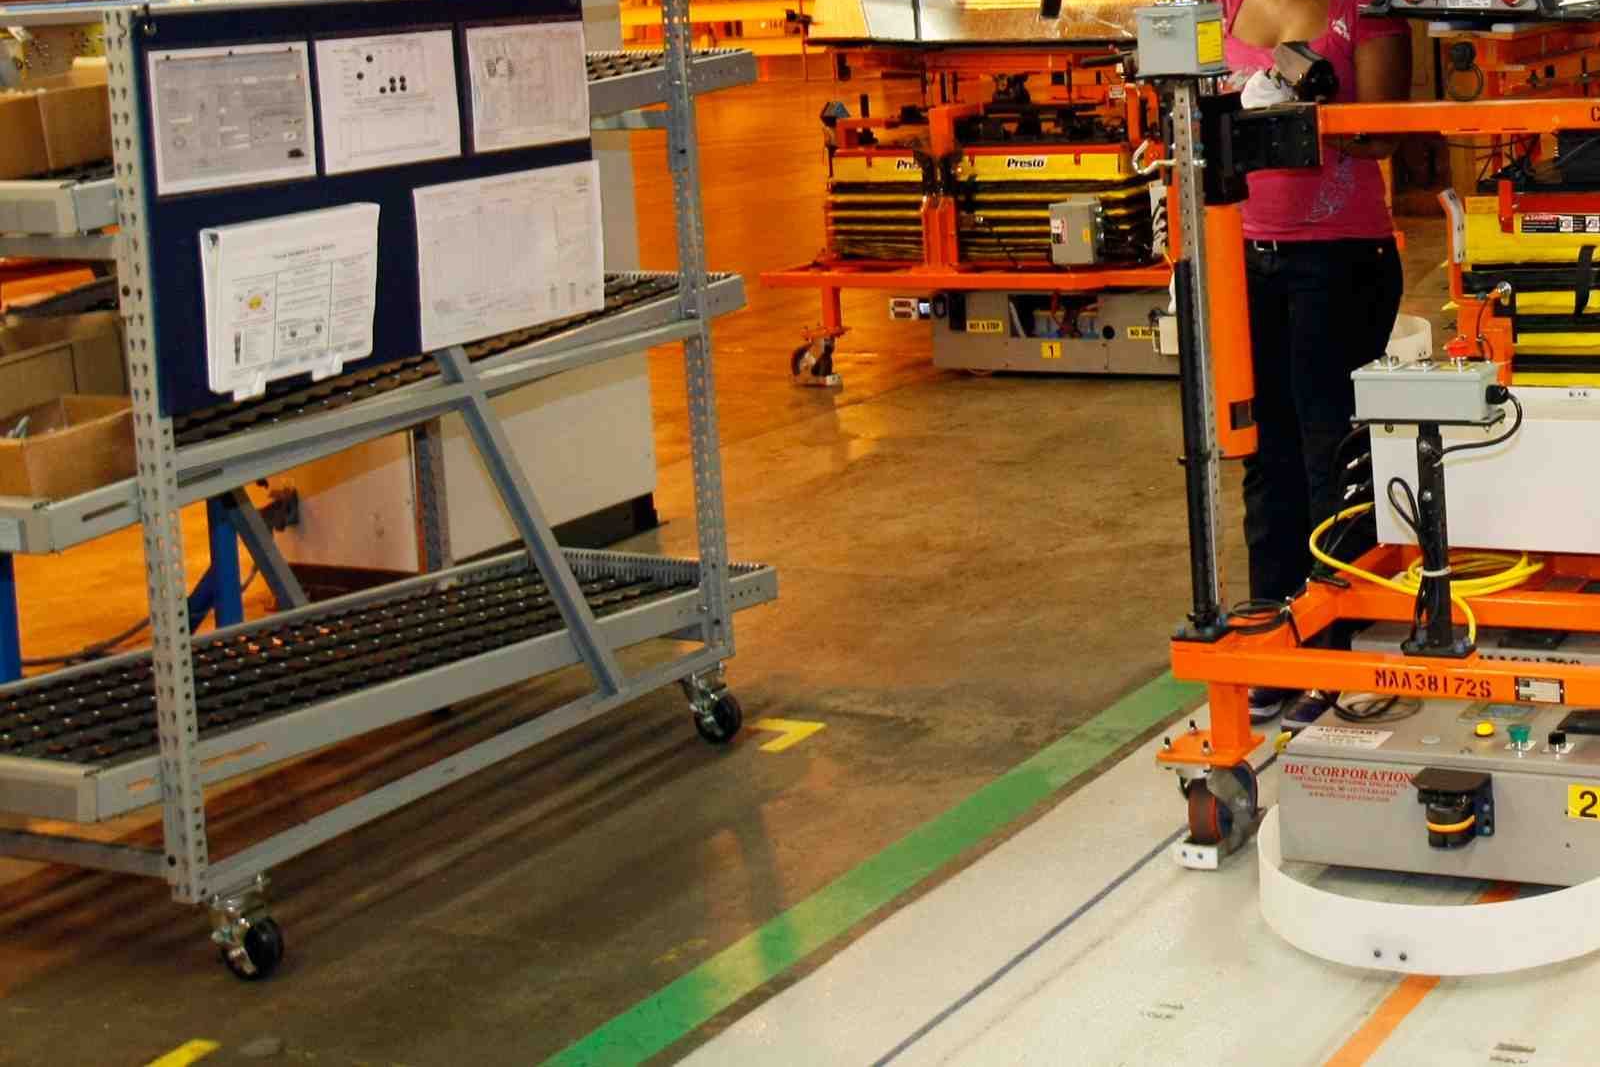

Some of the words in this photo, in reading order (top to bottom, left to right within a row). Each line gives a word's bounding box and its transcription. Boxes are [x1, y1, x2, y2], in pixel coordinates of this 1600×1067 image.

[1007, 157, 1045, 168] Presto
[1312, 765, 1411, 783] CORPORATION
[1579, 790, 1598, 818] 2
